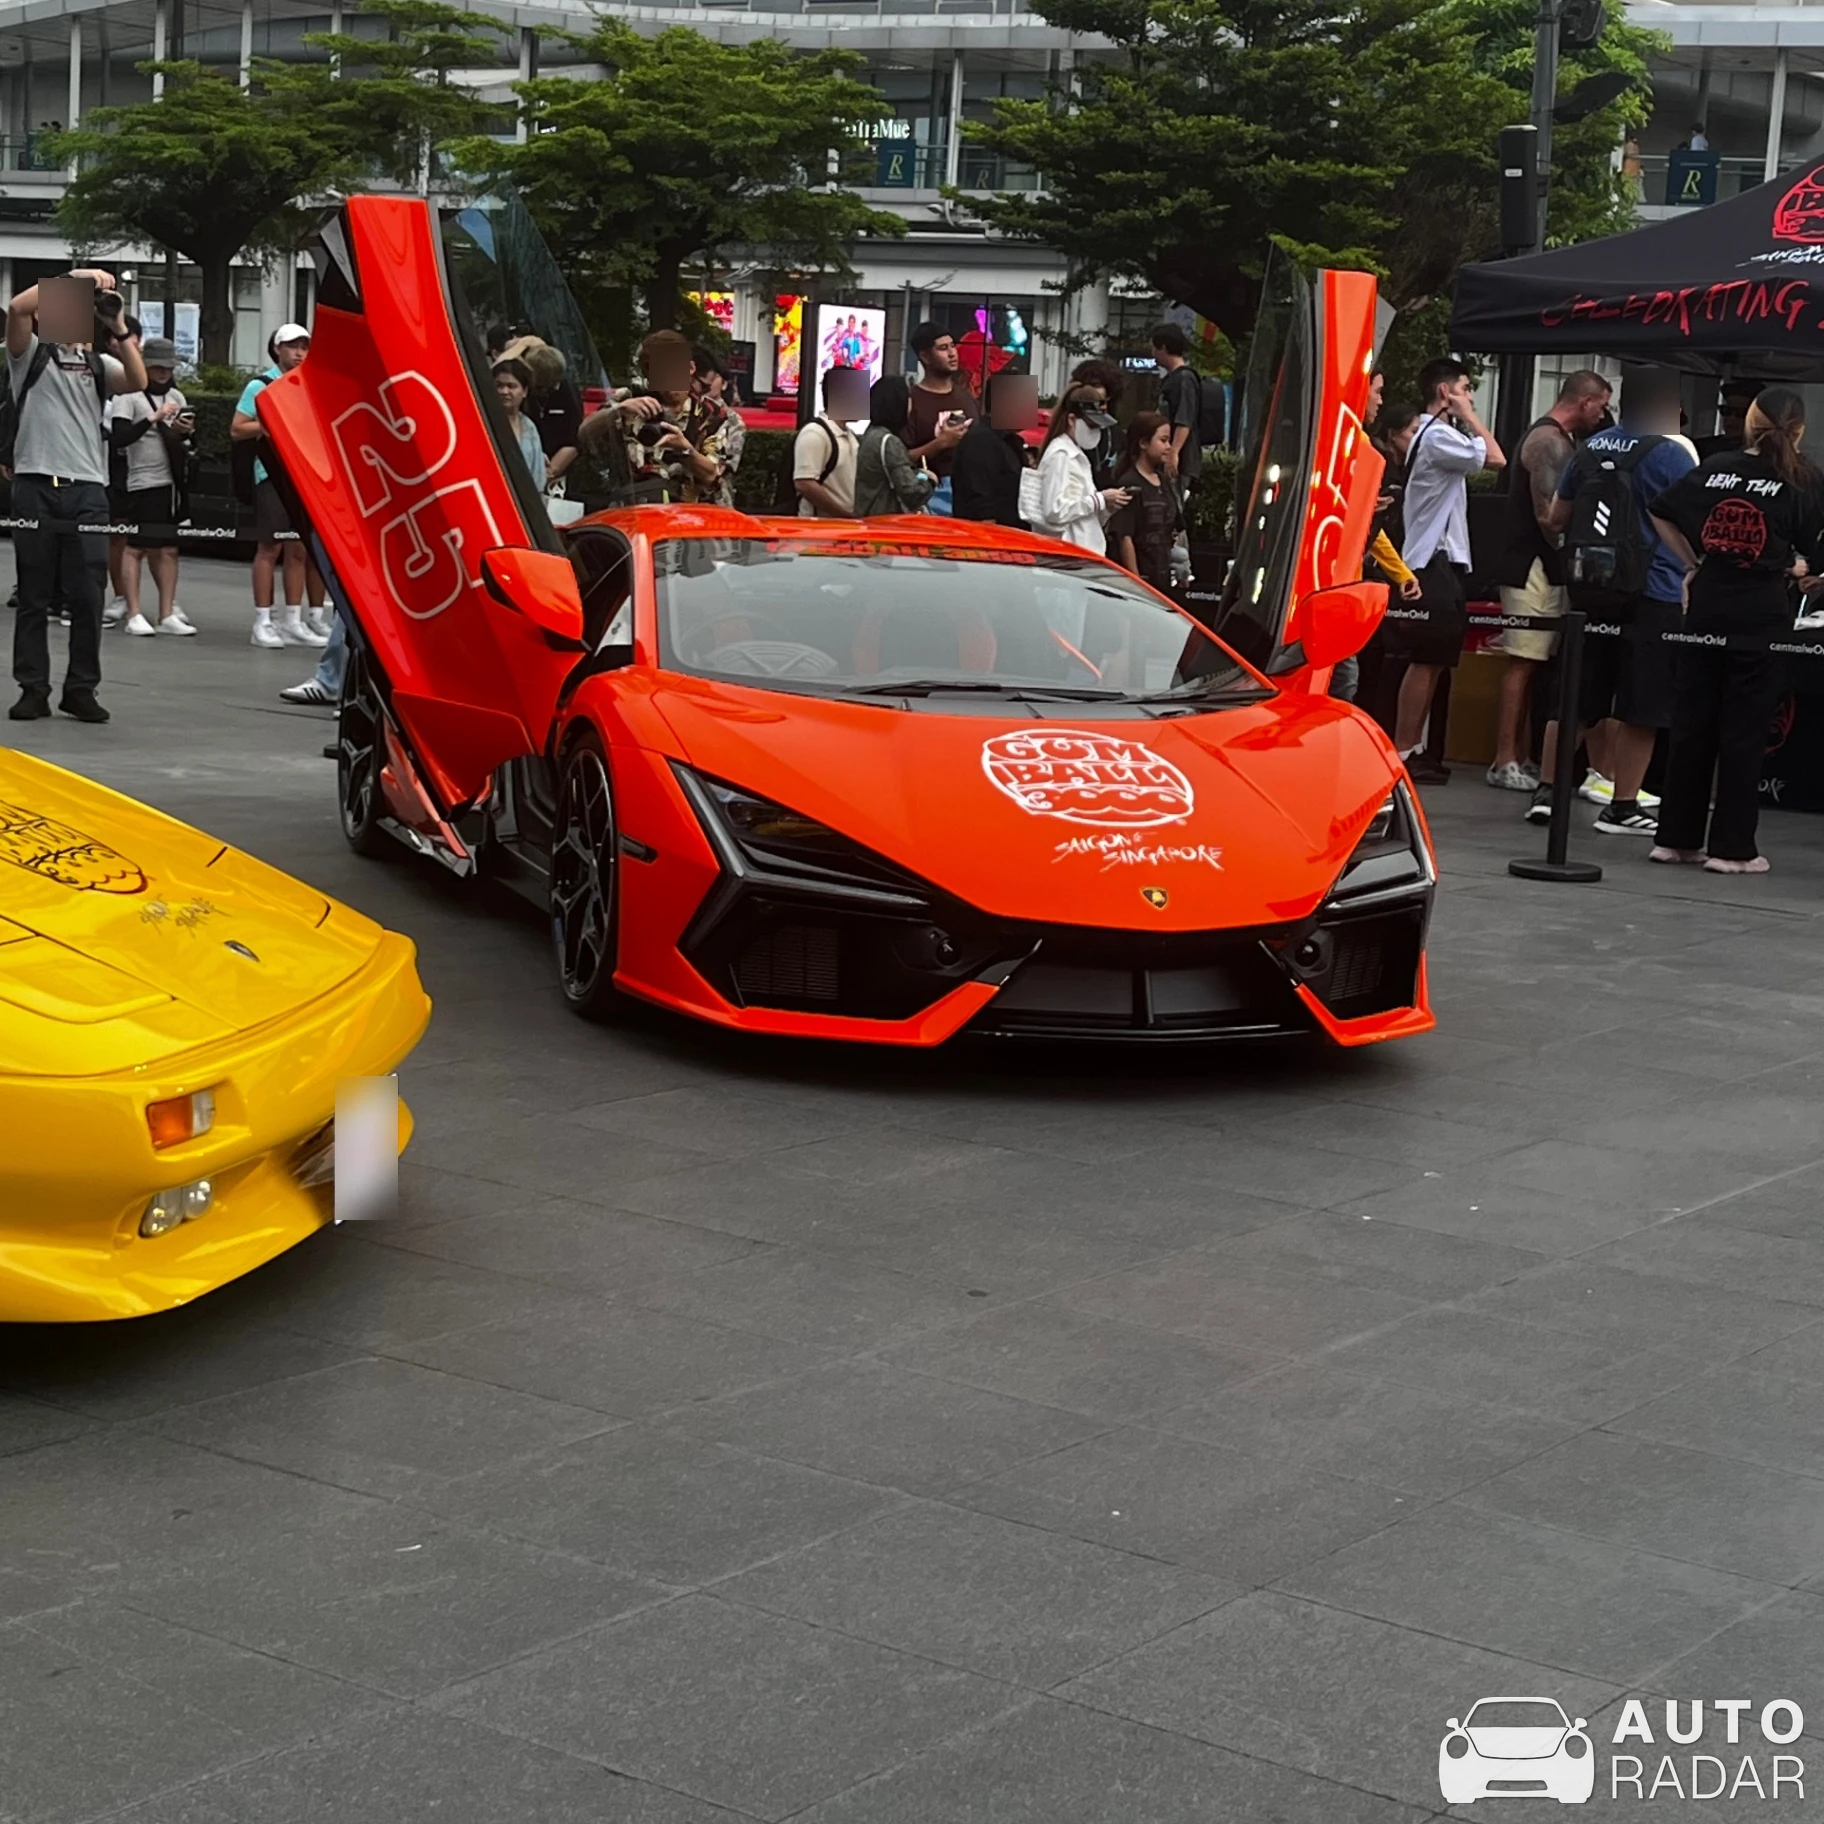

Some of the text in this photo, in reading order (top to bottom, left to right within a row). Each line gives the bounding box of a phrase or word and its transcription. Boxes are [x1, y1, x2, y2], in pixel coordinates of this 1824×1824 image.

[331, 369, 505, 621] 25
[1745, 479, 1783, 497] TEAM
[1469, 614, 1530, 627] centralwOrld
[1661, 632, 1727, 646] centralwOrld
[1051, 833, 1132, 863] SAIGON
[1100, 845, 1225, 872] SINGAPORE
